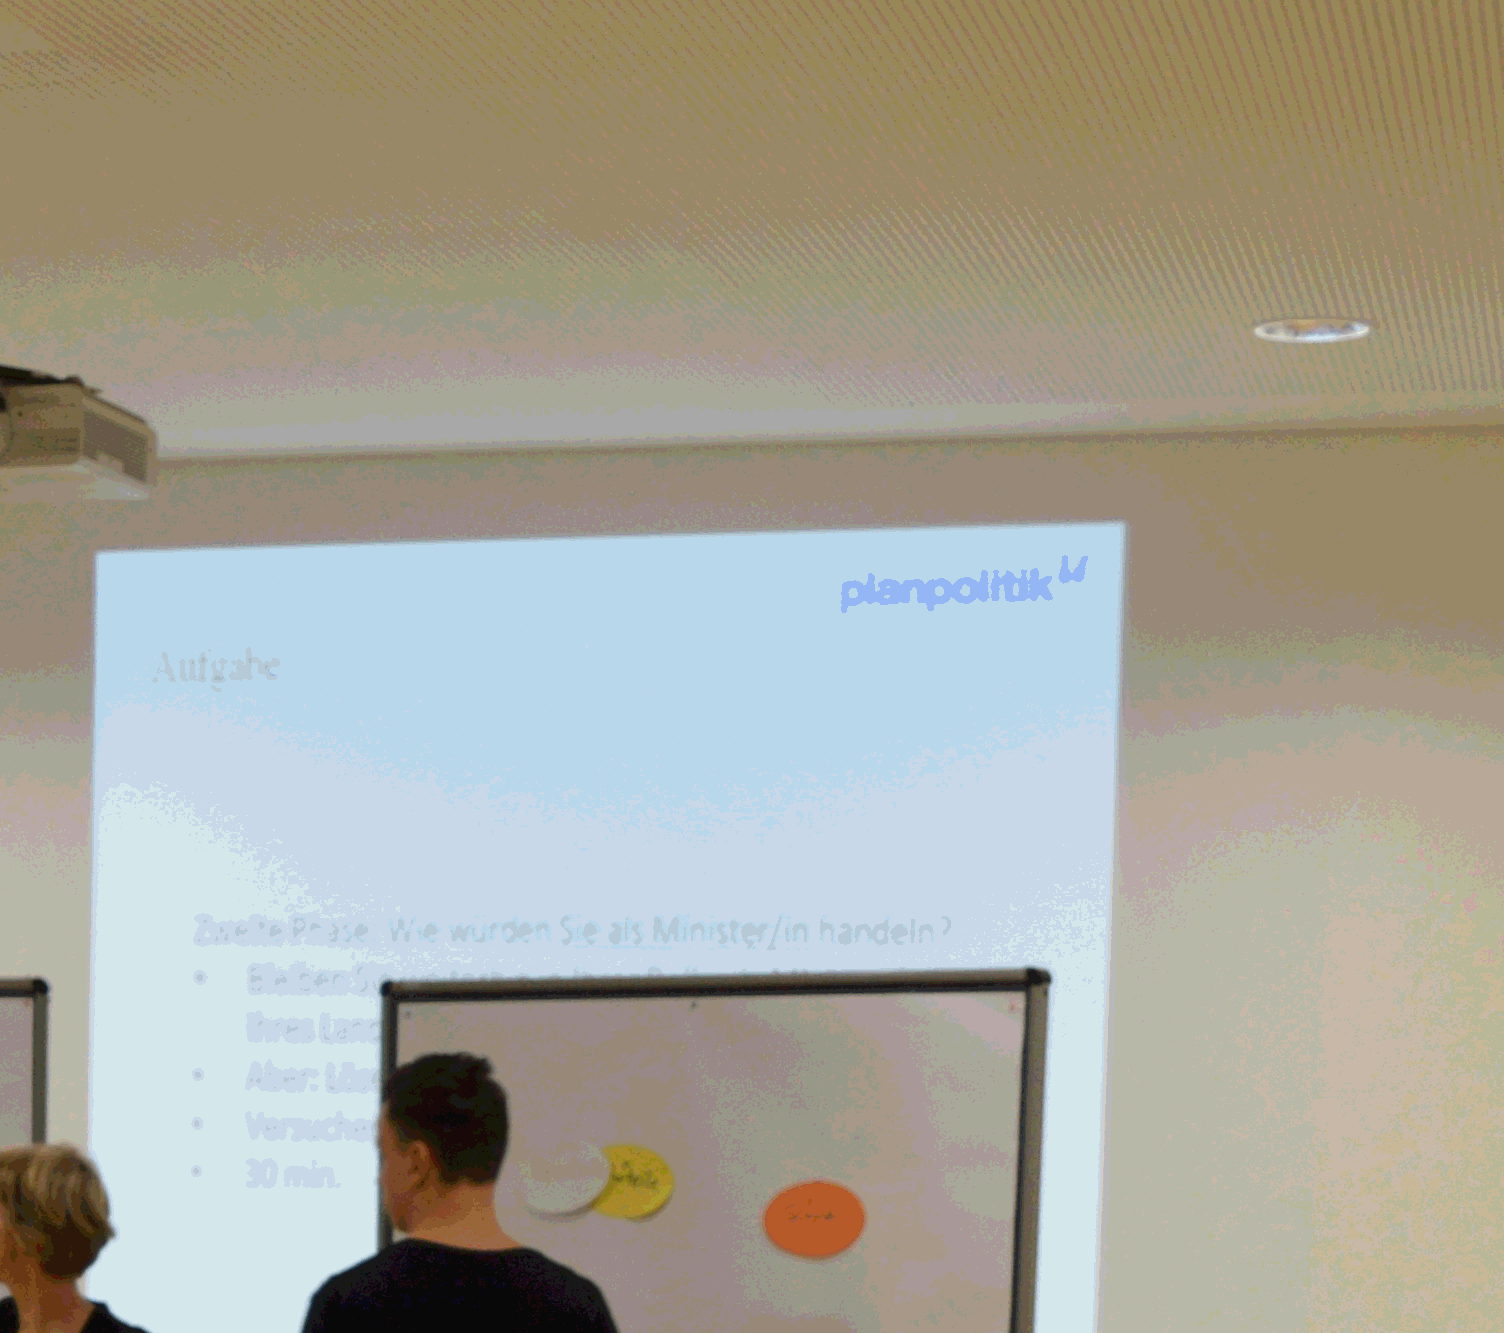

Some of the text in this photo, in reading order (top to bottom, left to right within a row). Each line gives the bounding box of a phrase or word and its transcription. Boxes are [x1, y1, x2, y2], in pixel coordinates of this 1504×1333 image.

[841, 568, 1053, 613] planpolitik
[392, 915, 439, 944] Wie
[559, 914, 599, 945] Sie
[608, 914, 645, 945] als
[652, 912, 810, 951] Minister/in
[819, 914, 952, 946] handeln?
[246, 1158, 279, 1189] 30
